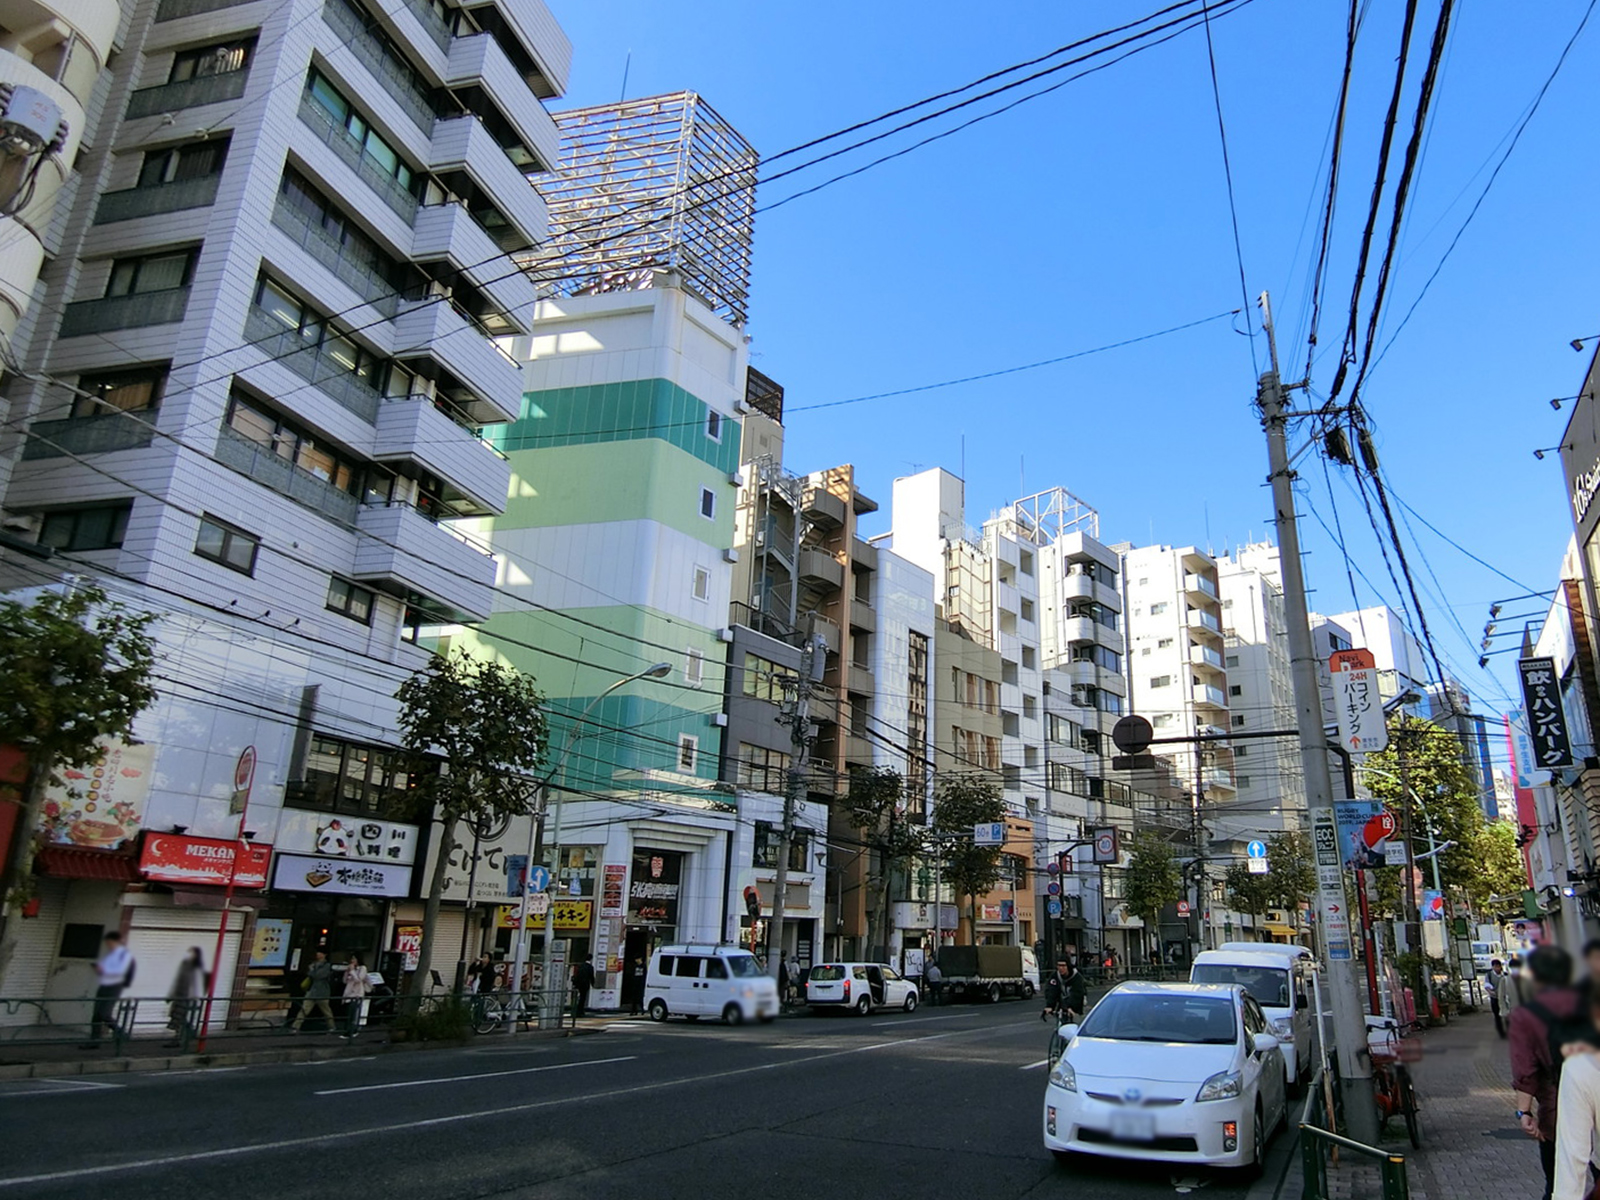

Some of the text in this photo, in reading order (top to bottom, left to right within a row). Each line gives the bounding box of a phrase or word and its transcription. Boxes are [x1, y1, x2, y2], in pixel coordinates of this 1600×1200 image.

[1349, 672, 1367, 681] 24H
[1344, 682, 1361, 734] パーキング
[1357, 682, 1371, 713] コイン
[1316, 829, 1334, 840] ECC
